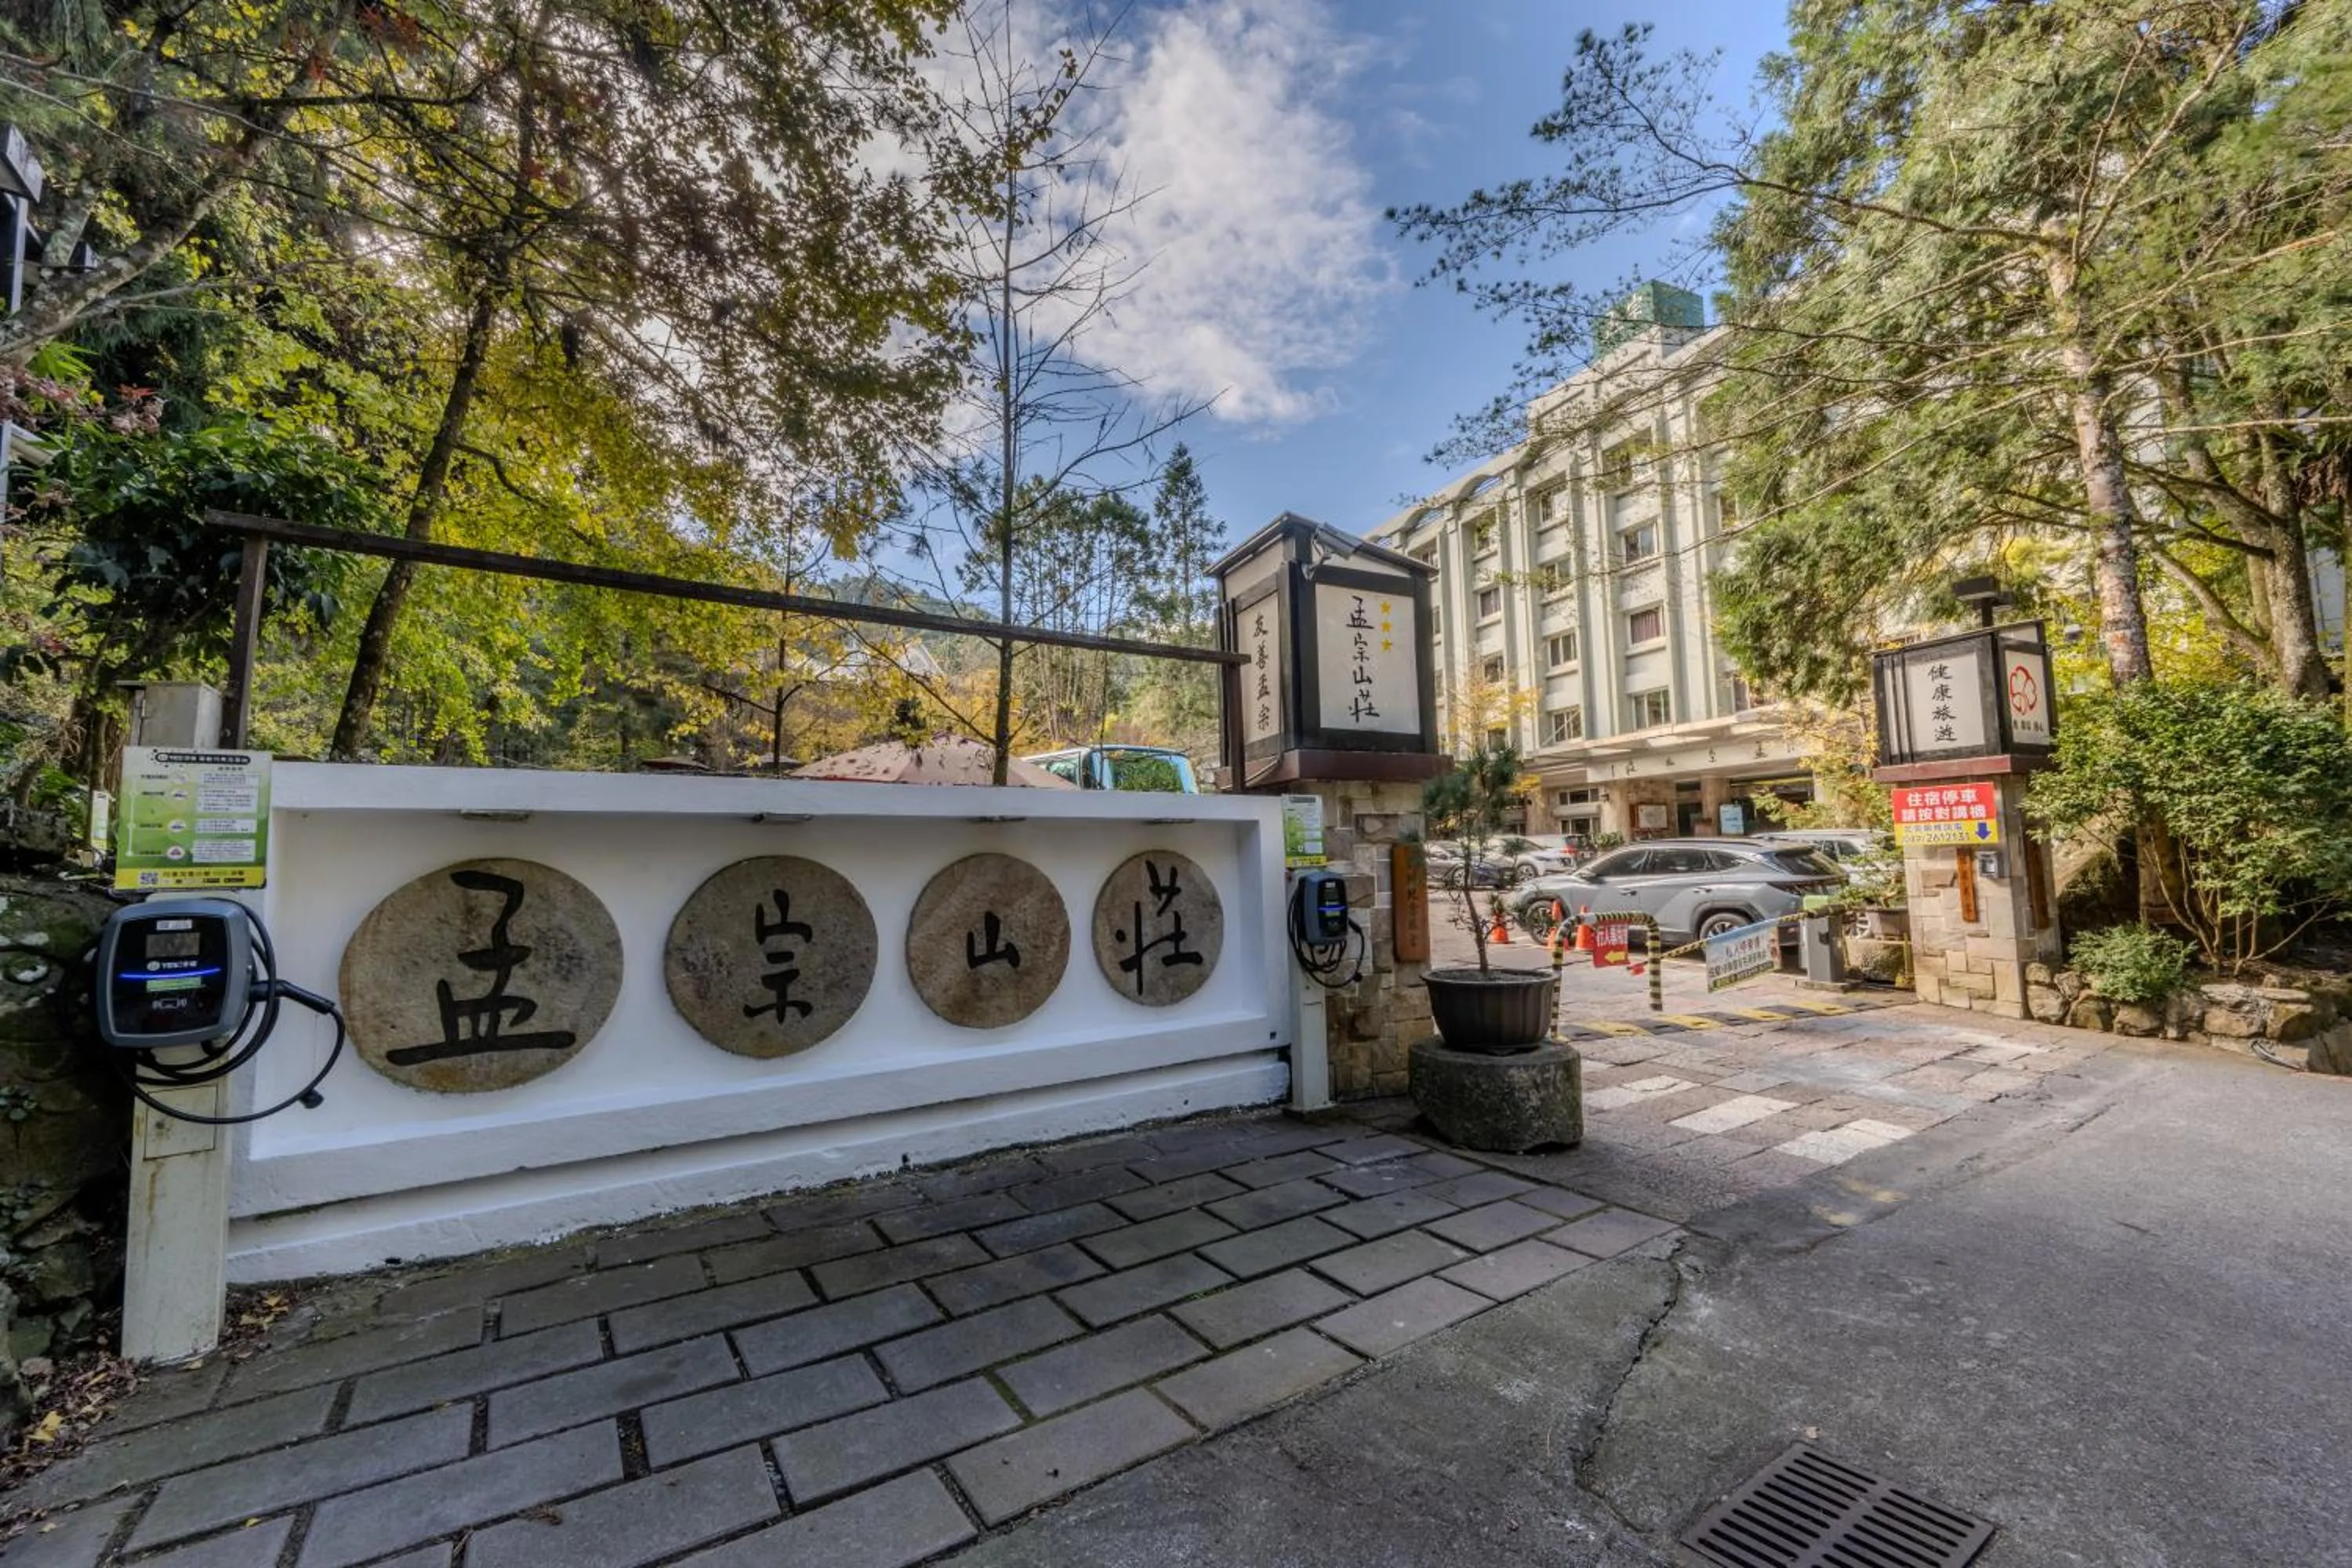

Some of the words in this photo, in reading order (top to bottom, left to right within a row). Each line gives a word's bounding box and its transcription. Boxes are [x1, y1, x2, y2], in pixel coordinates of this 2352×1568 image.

[1253, 613, 1271, 731] 友善孟宗
[1346, 595, 1381, 724] 孟宗山莊
[1926, 662, 1958, 742] 健康旅遊
[1901, 804, 1987, 822] 請按對講機
[1907, 789, 1977, 807] 住宿停車
